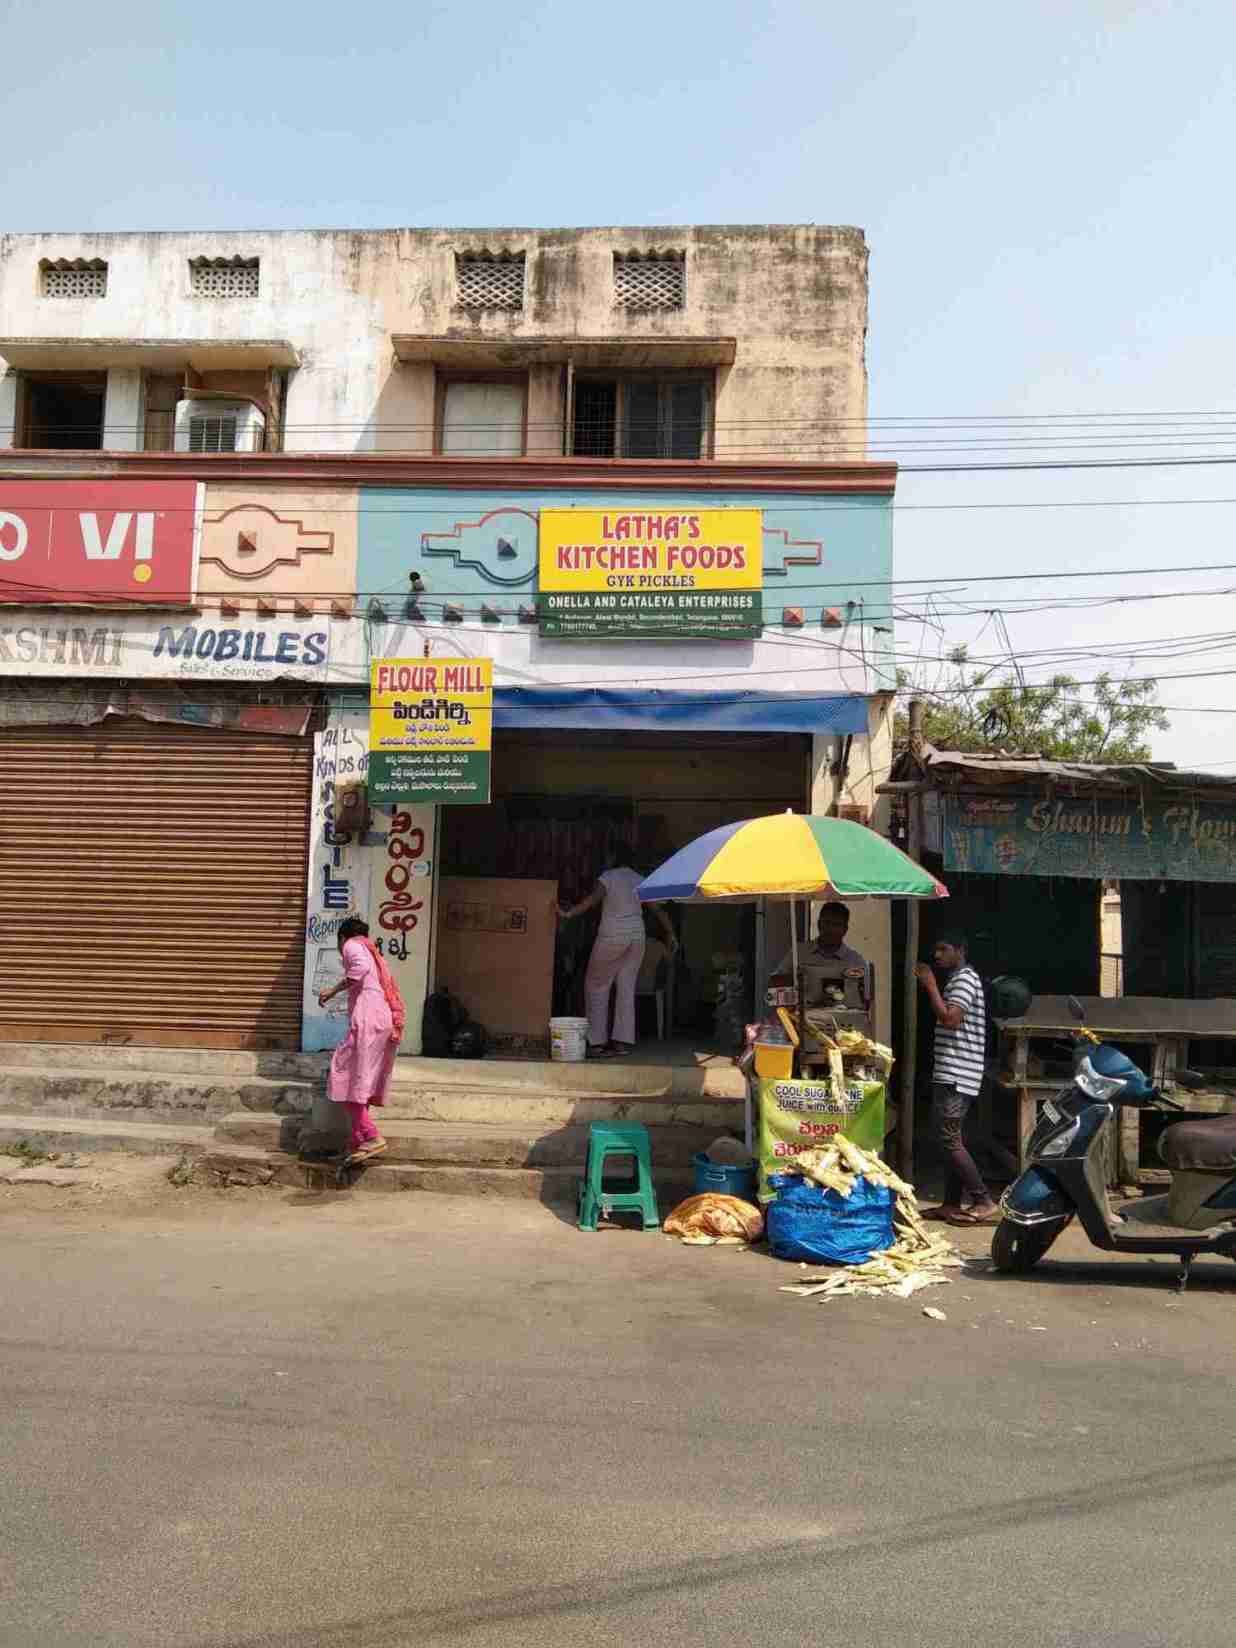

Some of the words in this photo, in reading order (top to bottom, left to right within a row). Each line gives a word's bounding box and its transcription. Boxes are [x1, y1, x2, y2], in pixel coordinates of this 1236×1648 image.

[603, 515, 700, 540] LATHA'S
[558, 546, 657, 570] KITCHEN
[667, 546, 745, 570] FOODS
[607, 575, 634, 587] GYK
[639, 575, 695, 587] PICKLES
[548, 596, 590, 608] ONELLA
[594, 596, 616, 608] AND
[620, 596, 675, 608] CATALEYA
[678, 595, 753, 608] ENTERPRISES
[153, 626, 327, 664] MOBILES
[378, 666, 437, 693] FLOUR
[444, 666, 485, 692] MILL
[322, 728, 352, 746] ALL
[315, 756, 354, 779] KINDS
[775, 1086, 801, 1097] COOL
[776, 1099, 804, 1110] JUICE
